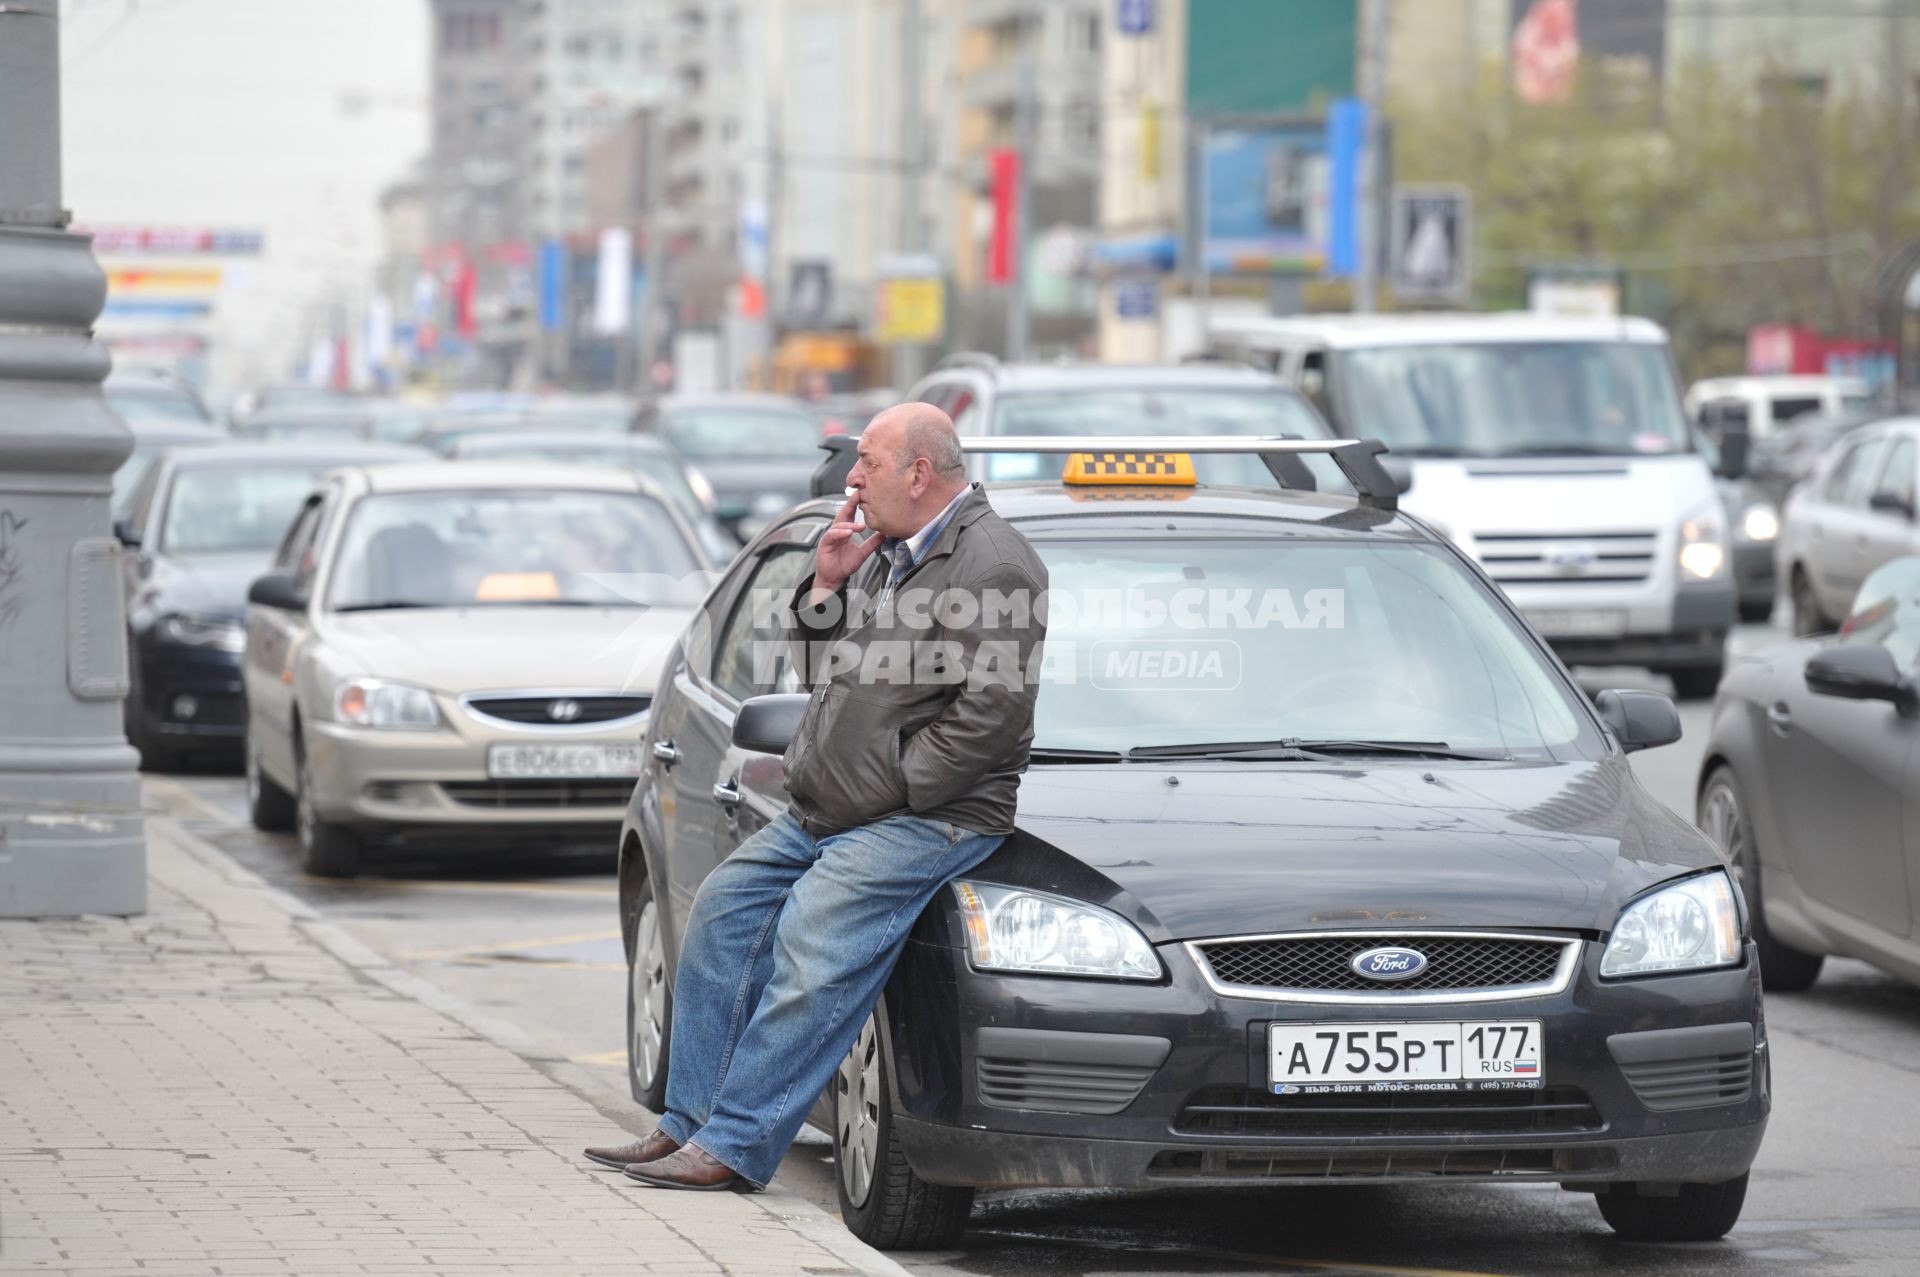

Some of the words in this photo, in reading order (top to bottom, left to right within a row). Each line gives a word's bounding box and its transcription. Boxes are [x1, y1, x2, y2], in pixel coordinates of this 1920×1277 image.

[1371, 953, 1410, 971] Ford
[1467, 1026, 1529, 1059] 177
[1481, 1061, 1513, 1073] RUS
[1304, 1084, 1362, 1094] НЬЮ-ЙОРК
[1368, 1082, 1458, 1092] МОТОРС-МОСКВА
[1480, 1081, 1500, 1090] (495)
